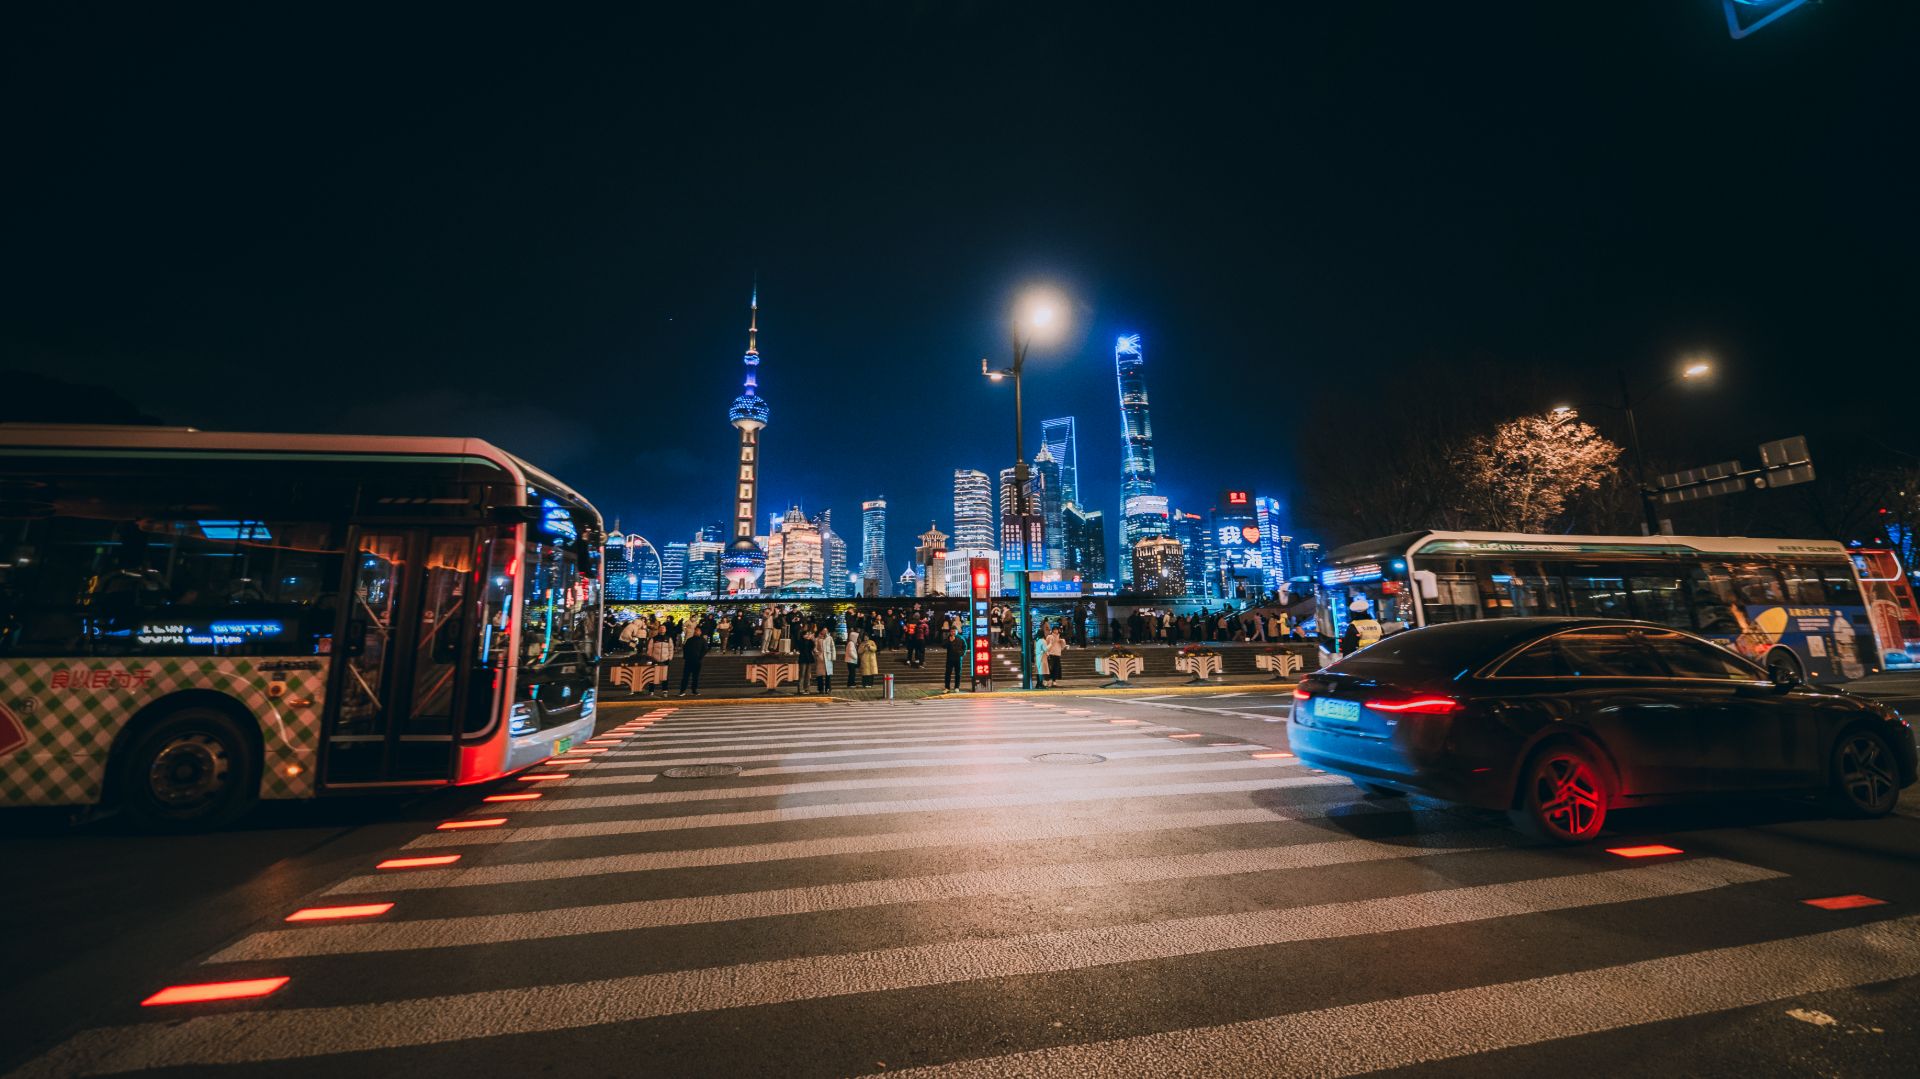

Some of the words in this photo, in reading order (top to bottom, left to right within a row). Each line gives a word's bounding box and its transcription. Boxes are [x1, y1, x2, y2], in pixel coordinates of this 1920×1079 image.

[1219, 526, 1242, 545] 我
[51, 669, 153, 689] 食以民为天
